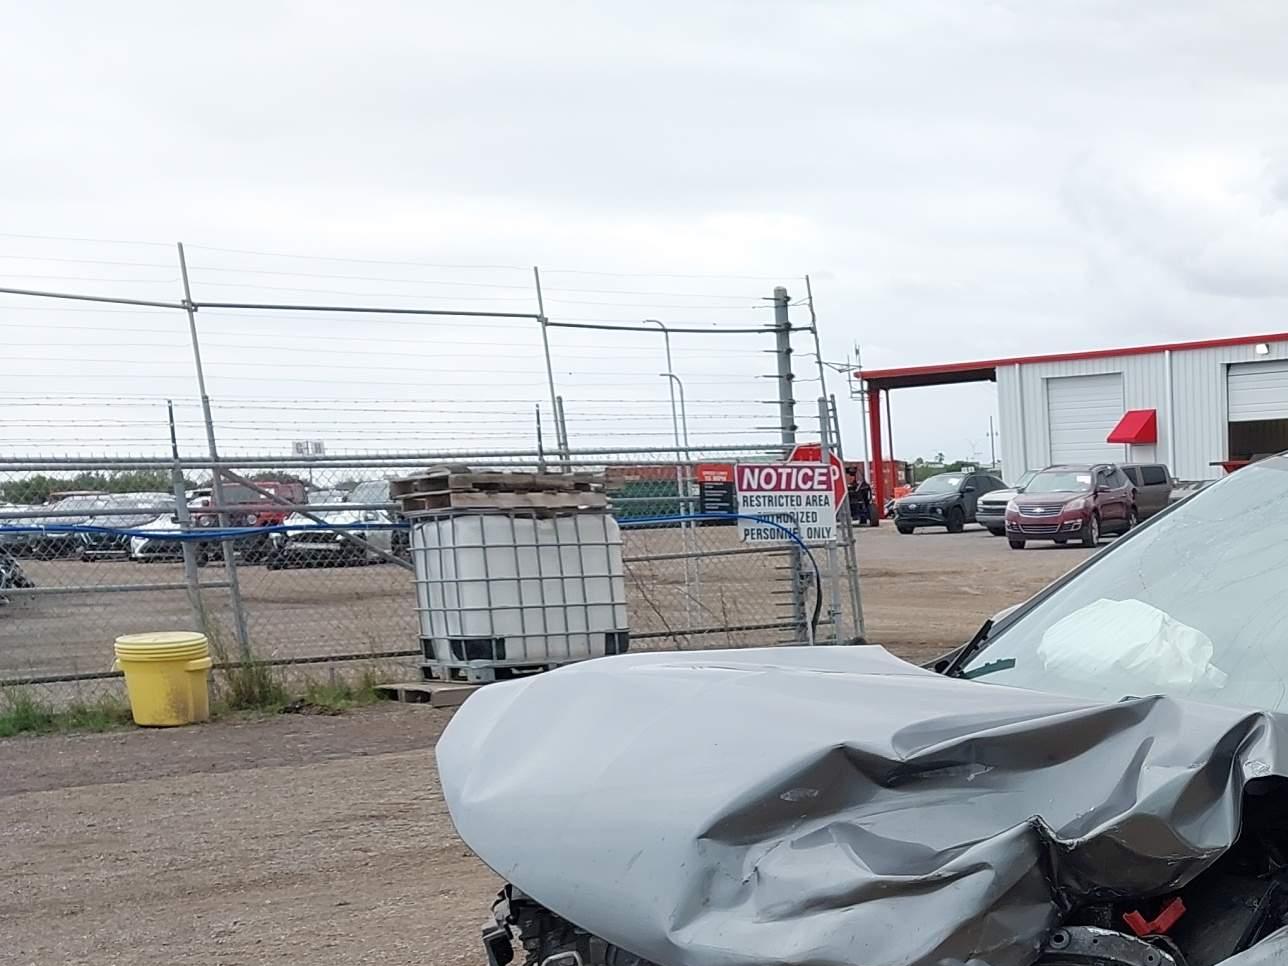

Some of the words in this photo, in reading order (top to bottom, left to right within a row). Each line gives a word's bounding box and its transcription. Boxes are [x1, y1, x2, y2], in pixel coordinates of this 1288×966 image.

[742, 467, 828, 490] NOTICE
[742, 495, 802, 507] RESTRICTED
[805, 495, 830, 507] AREA
[806, 526, 832, 539] ONLY
